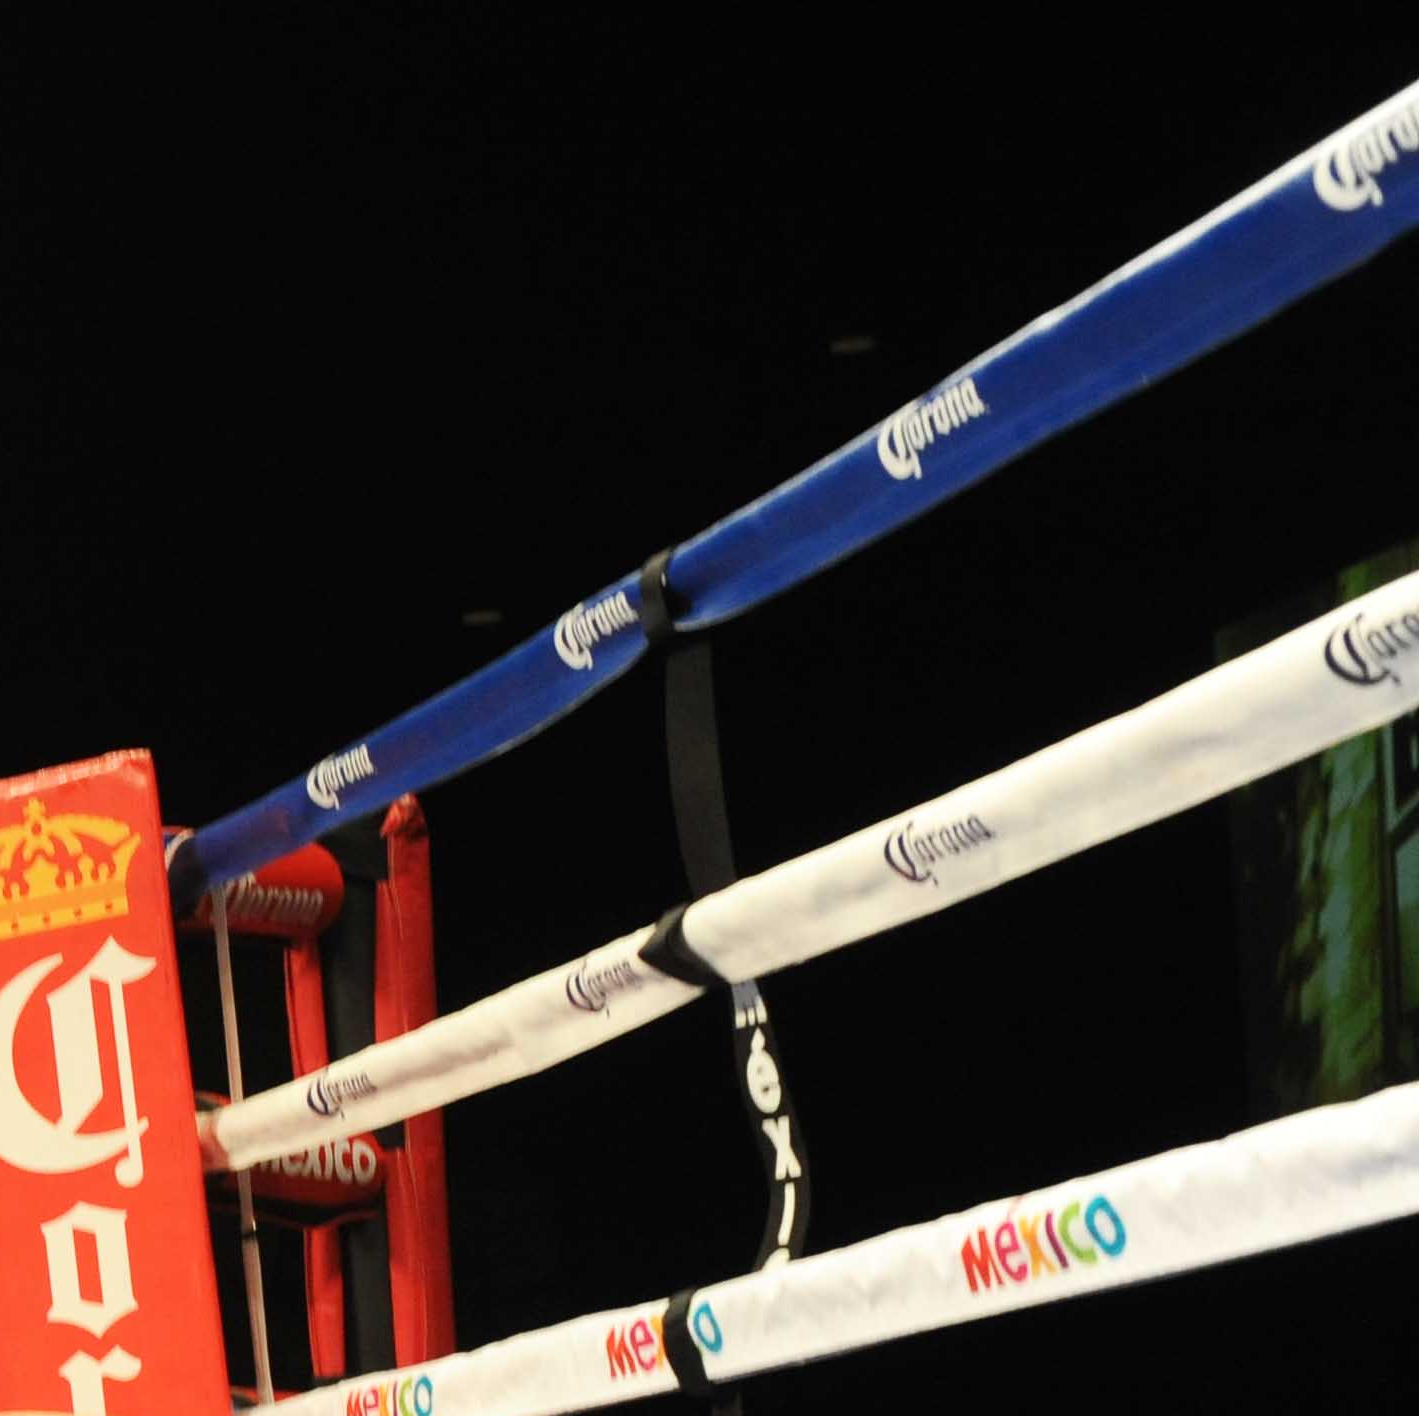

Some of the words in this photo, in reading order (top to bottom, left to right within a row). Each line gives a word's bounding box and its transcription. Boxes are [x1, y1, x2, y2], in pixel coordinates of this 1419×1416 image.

[1312, 104, 1419, 211] Coro
[877, 377, 987, 480] Corona
[553, 591, 638, 671] Corona
[1324, 610, 1419, 688] Coro
[306, 744, 375, 810] Corona
[883, 813, 996, 887] Corona
[307, 1070, 377, 1119] Corona
